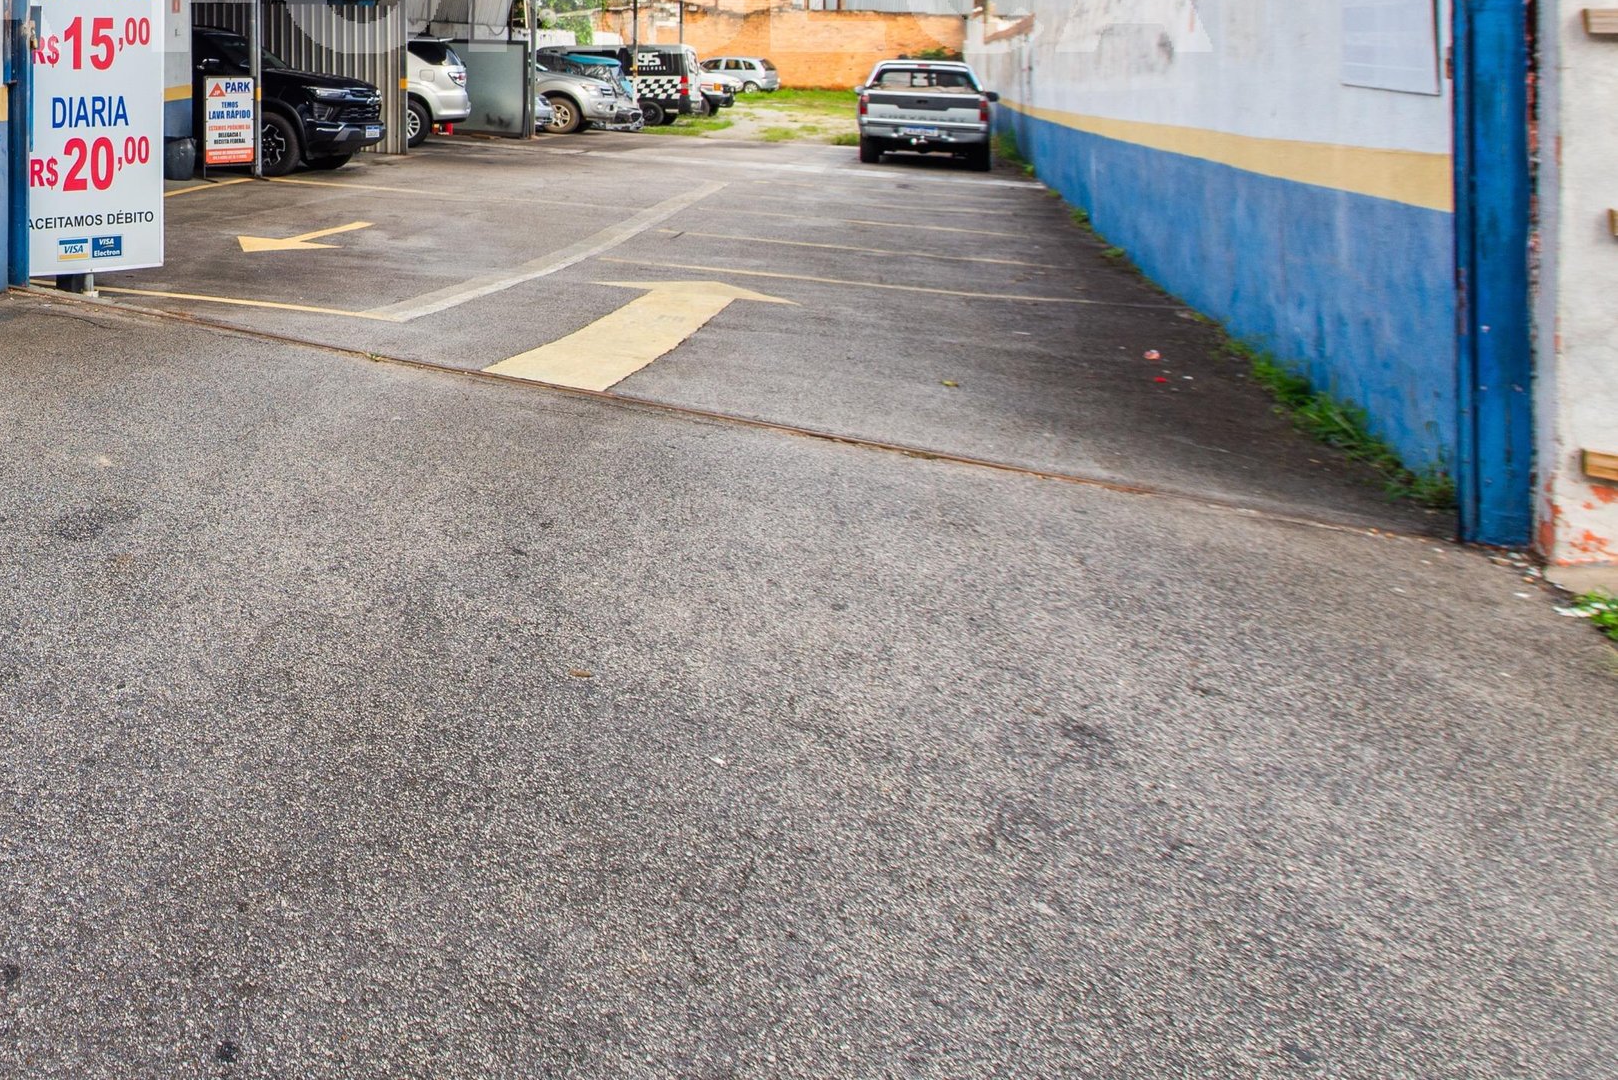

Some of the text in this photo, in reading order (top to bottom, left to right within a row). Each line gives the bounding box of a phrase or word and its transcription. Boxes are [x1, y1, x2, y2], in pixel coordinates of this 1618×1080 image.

[225, 82, 250, 92] PARK
[52, 96, 129, 128] DIARIA
[209, 109, 251, 120] LAVA RÁPIDO
[29, 210, 154, 230] ACEITAMOS DÉBITO
[64, 245, 84, 254] VISA
